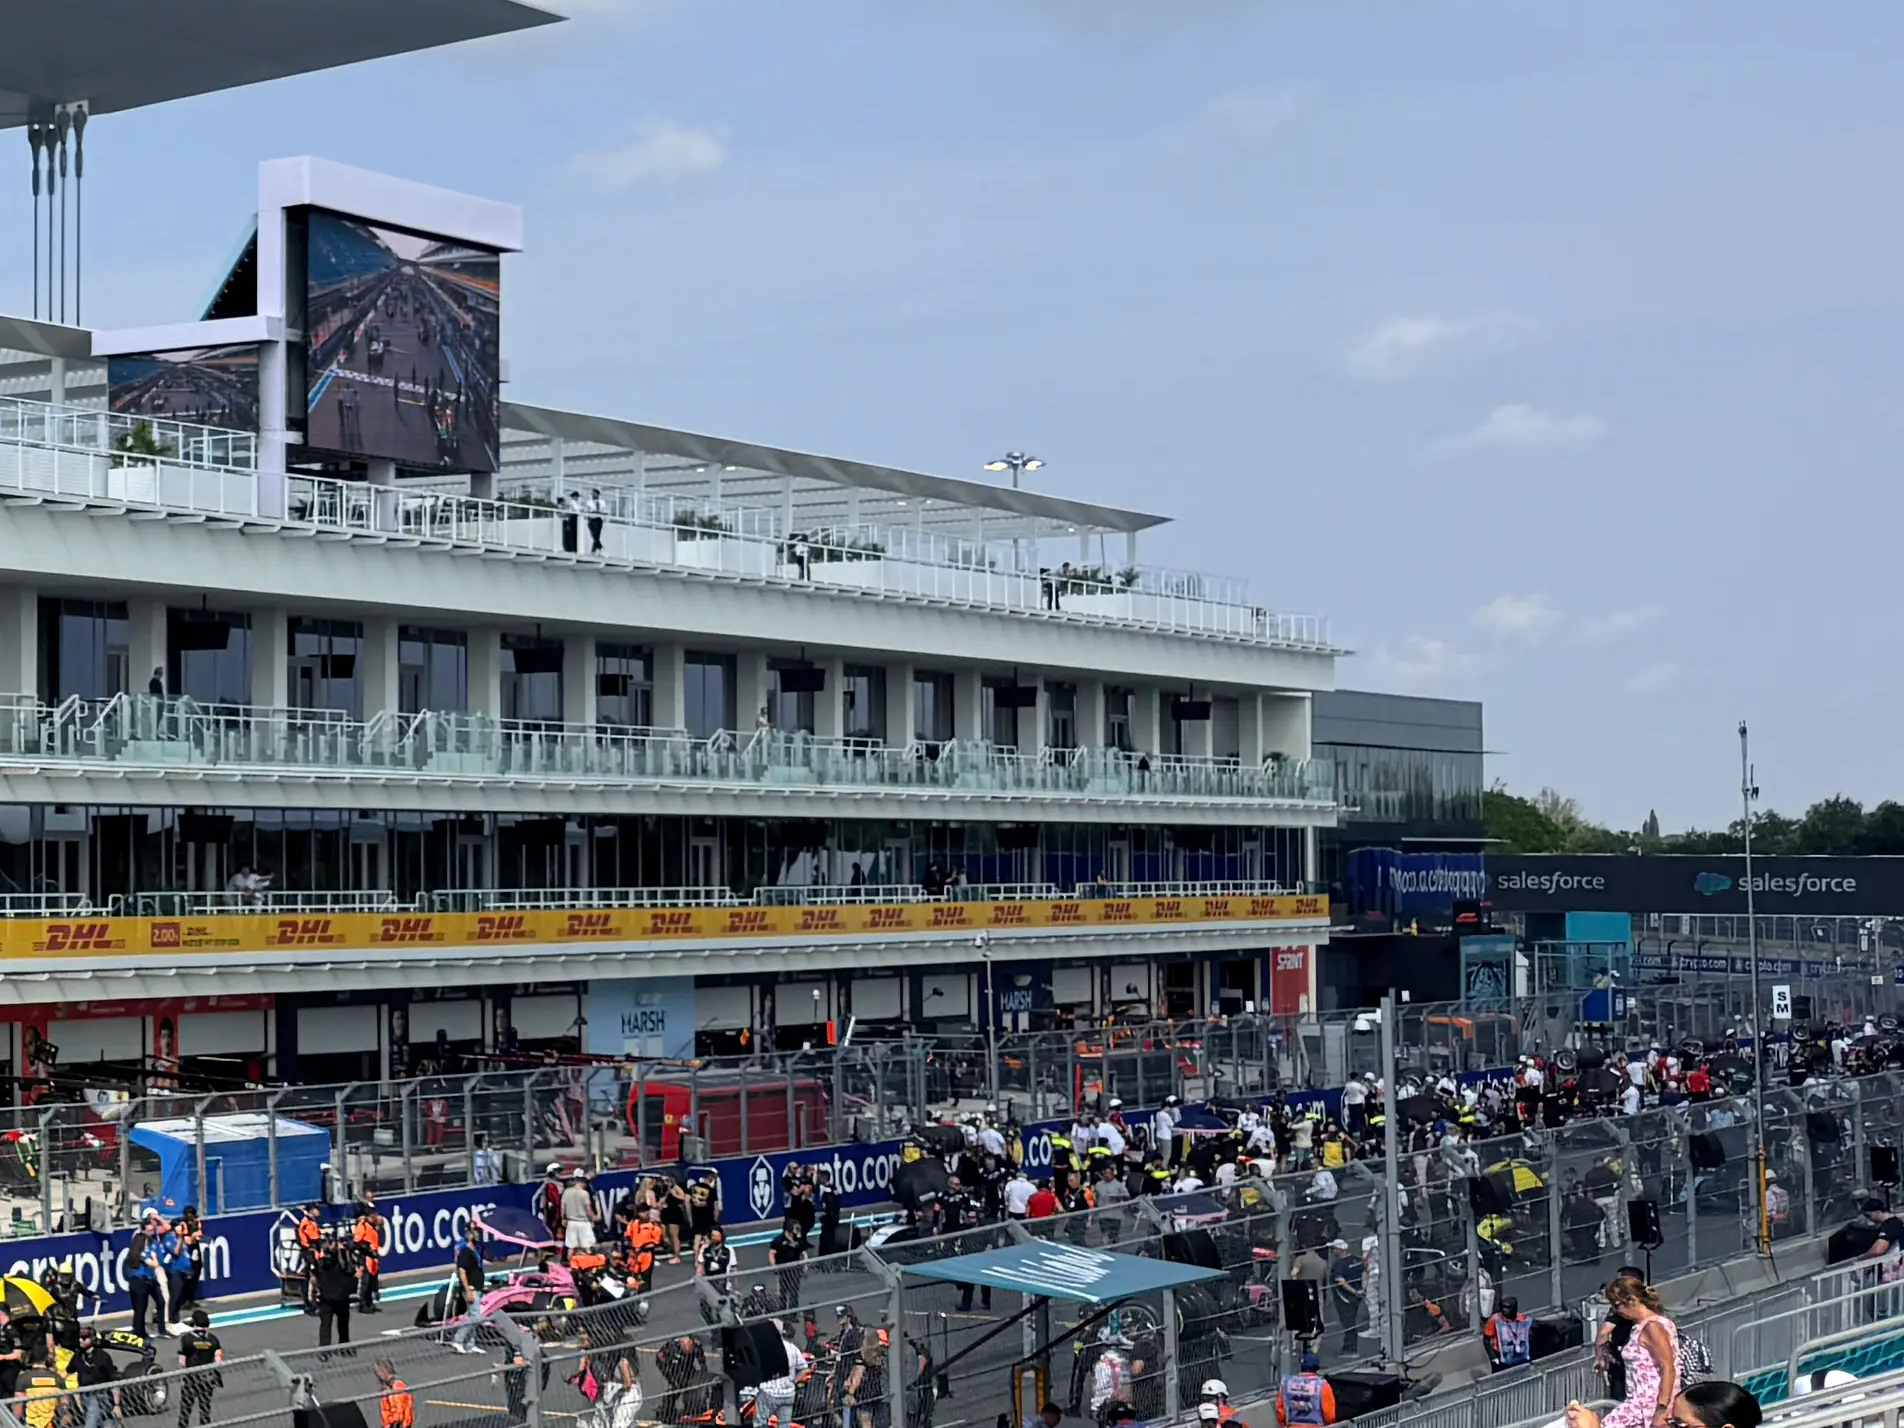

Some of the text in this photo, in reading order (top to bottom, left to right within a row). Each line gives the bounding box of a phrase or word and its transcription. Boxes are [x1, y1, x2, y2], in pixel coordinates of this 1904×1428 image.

[1497, 870, 1605, 895] salesforce
[1737, 870, 1857, 896] salesforce
[933, 906, 965, 926] DHL
[992, 904, 1024, 924] DHL
[1051, 903, 1080, 922] DHL
[1103, 902, 1131, 920] DHL
[1155, 901, 1182, 918] DHL
[1205, 900, 1230, 917] DHL
[1251, 898, 1276, 916] DHL
[1294, 897, 1318, 915] DHL
[474, 915, 524, 940] DHL
[566, 913, 614, 938] DHL
[649, 912, 694, 935] DHL
[727, 910, 769, 933] DHL
[800, 909, 838, 931] DHL
[869, 907, 905, 928] DHL
[45, 924, 113, 951] DHL
[275, 920, 335, 944] DHL
[380, 918, 435, 942] DHL
[1000, 989, 1032, 1011] MARSH
[620, 1010, 665, 1034] MARSH
